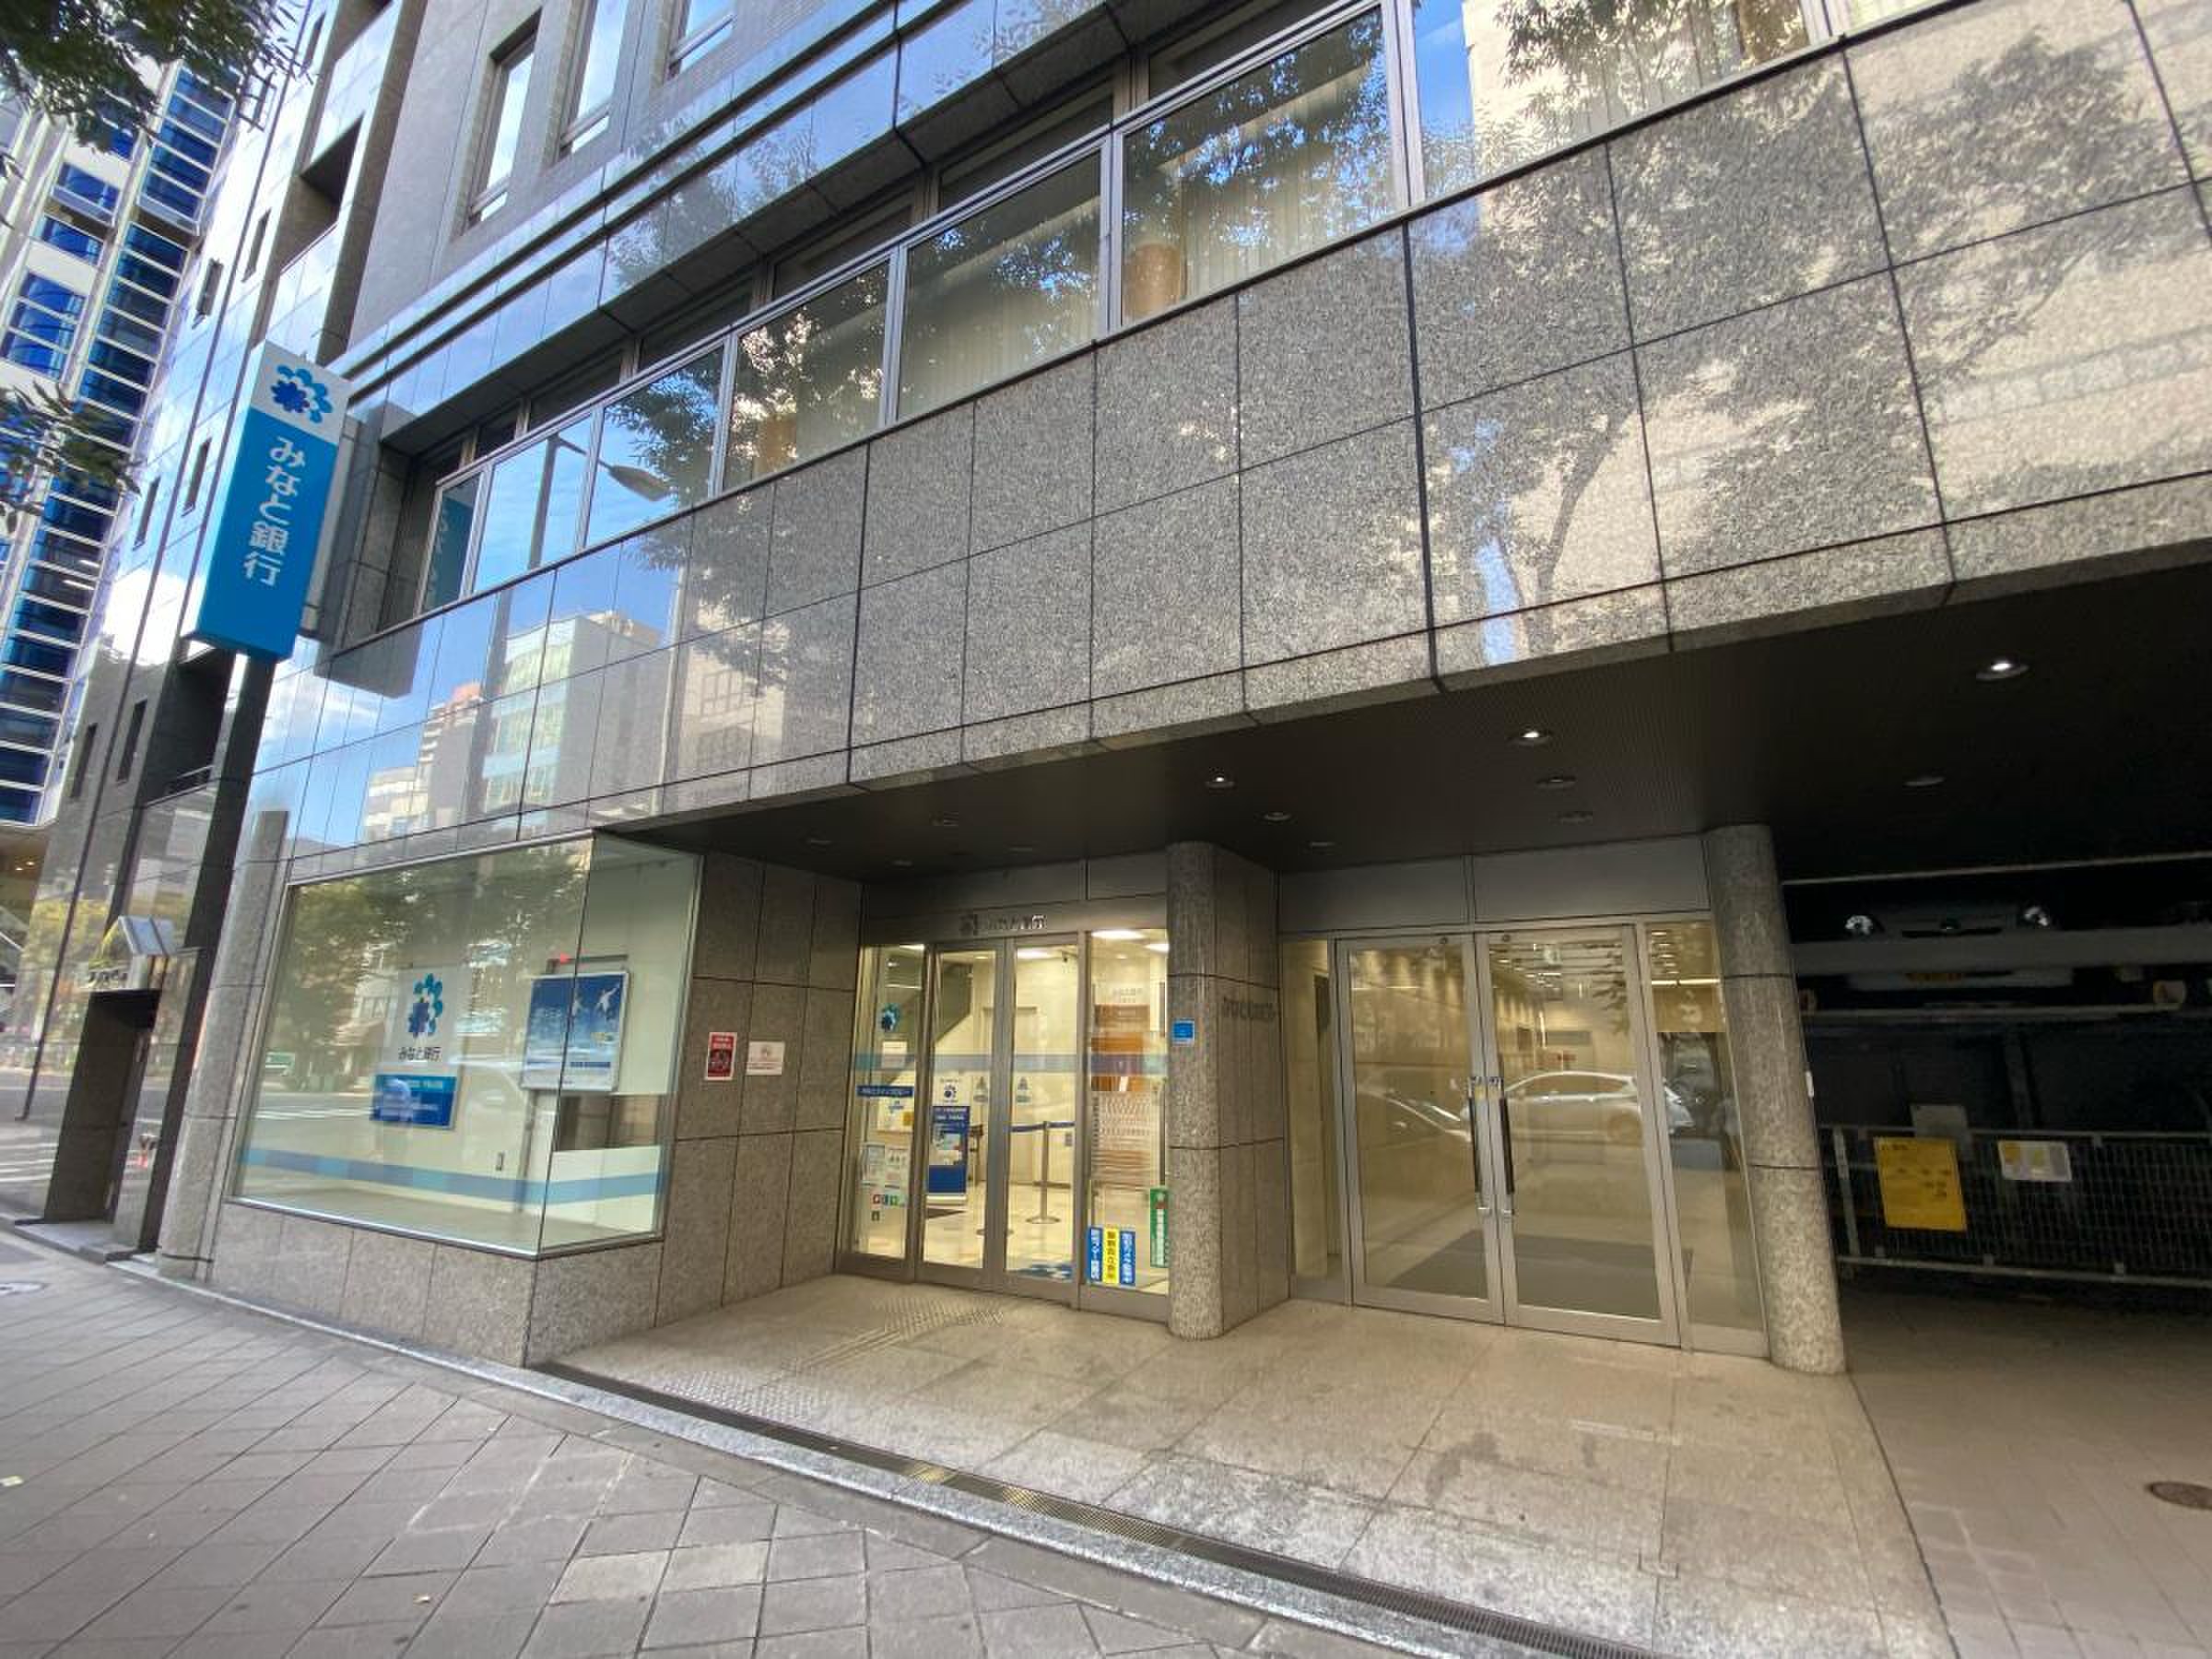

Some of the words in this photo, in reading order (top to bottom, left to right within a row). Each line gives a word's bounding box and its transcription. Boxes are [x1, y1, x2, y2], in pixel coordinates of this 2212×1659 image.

[243, 437, 306, 587] みなと銀行
